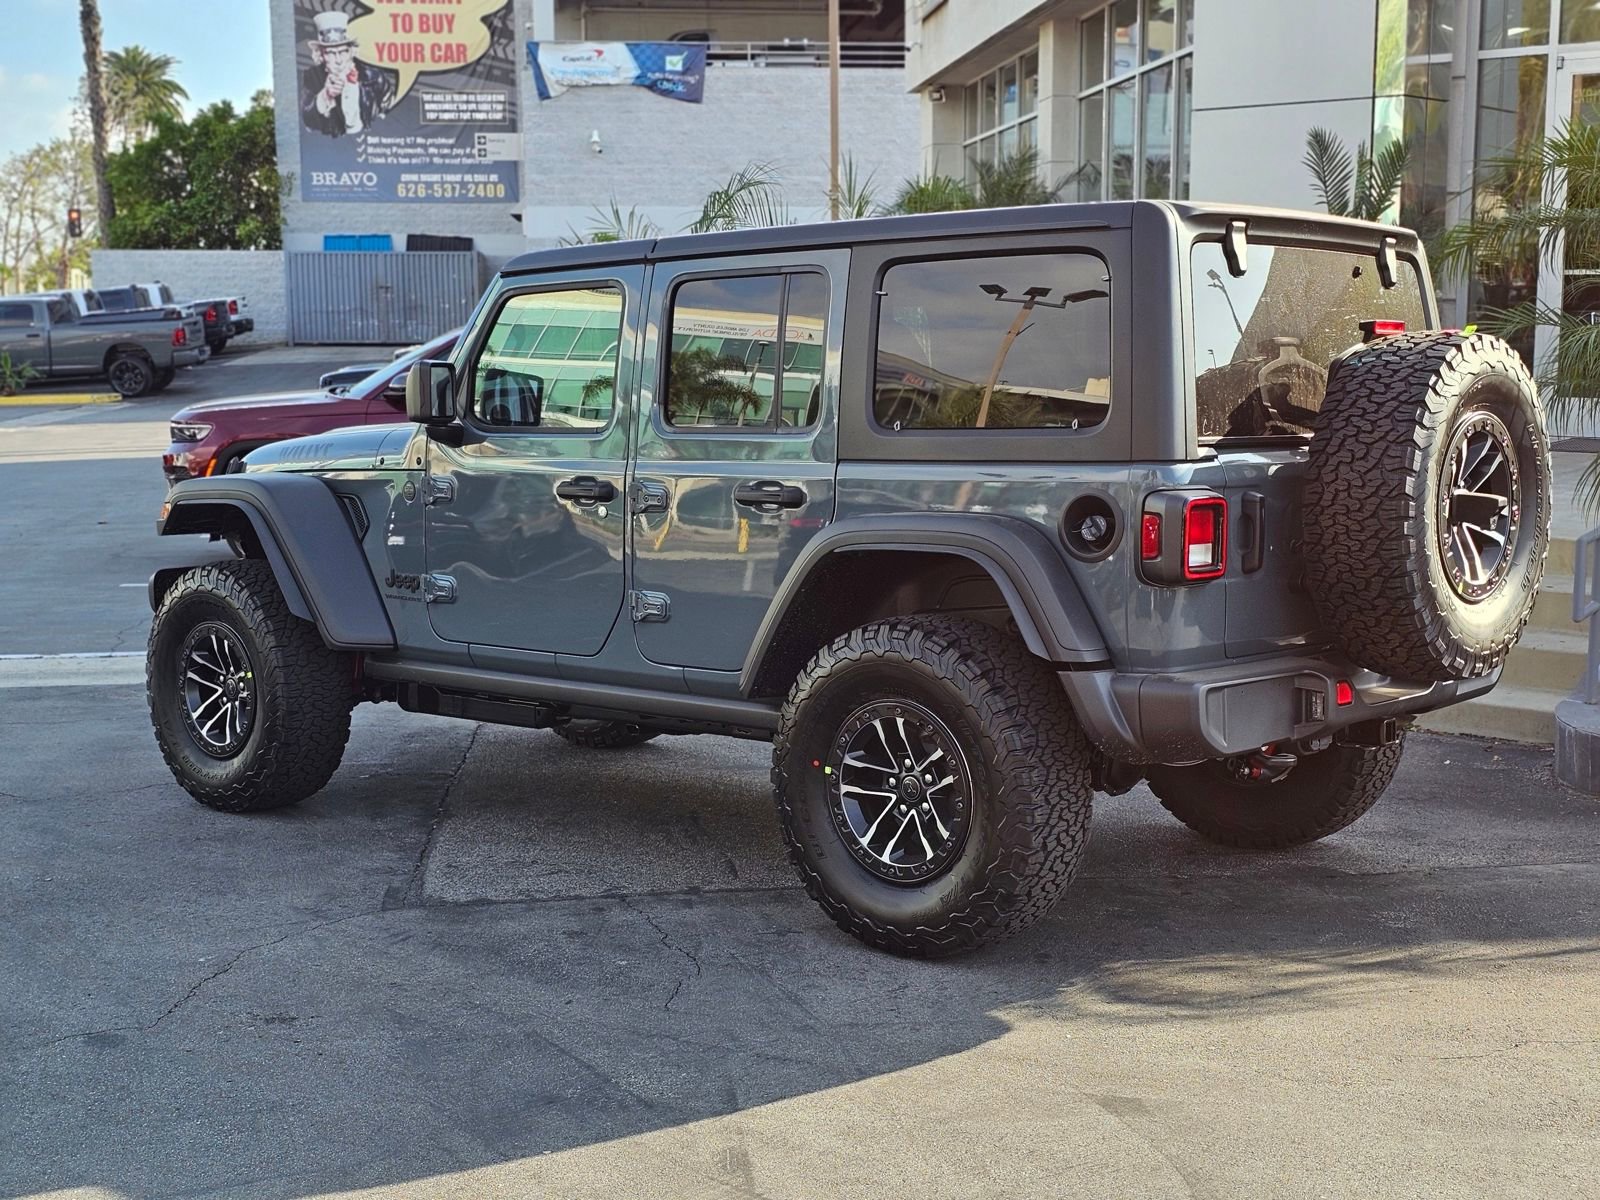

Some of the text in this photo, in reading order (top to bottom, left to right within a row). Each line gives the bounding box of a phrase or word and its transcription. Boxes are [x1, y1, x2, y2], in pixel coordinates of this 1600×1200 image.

[390, 13, 455, 34] TO BUY
[375, 42, 468, 63] YOUR CAR
[311, 172, 378, 187] BRAVO
[397, 183, 505, 198] 626-537-2400
[385, 568, 421, 593] Jeep
